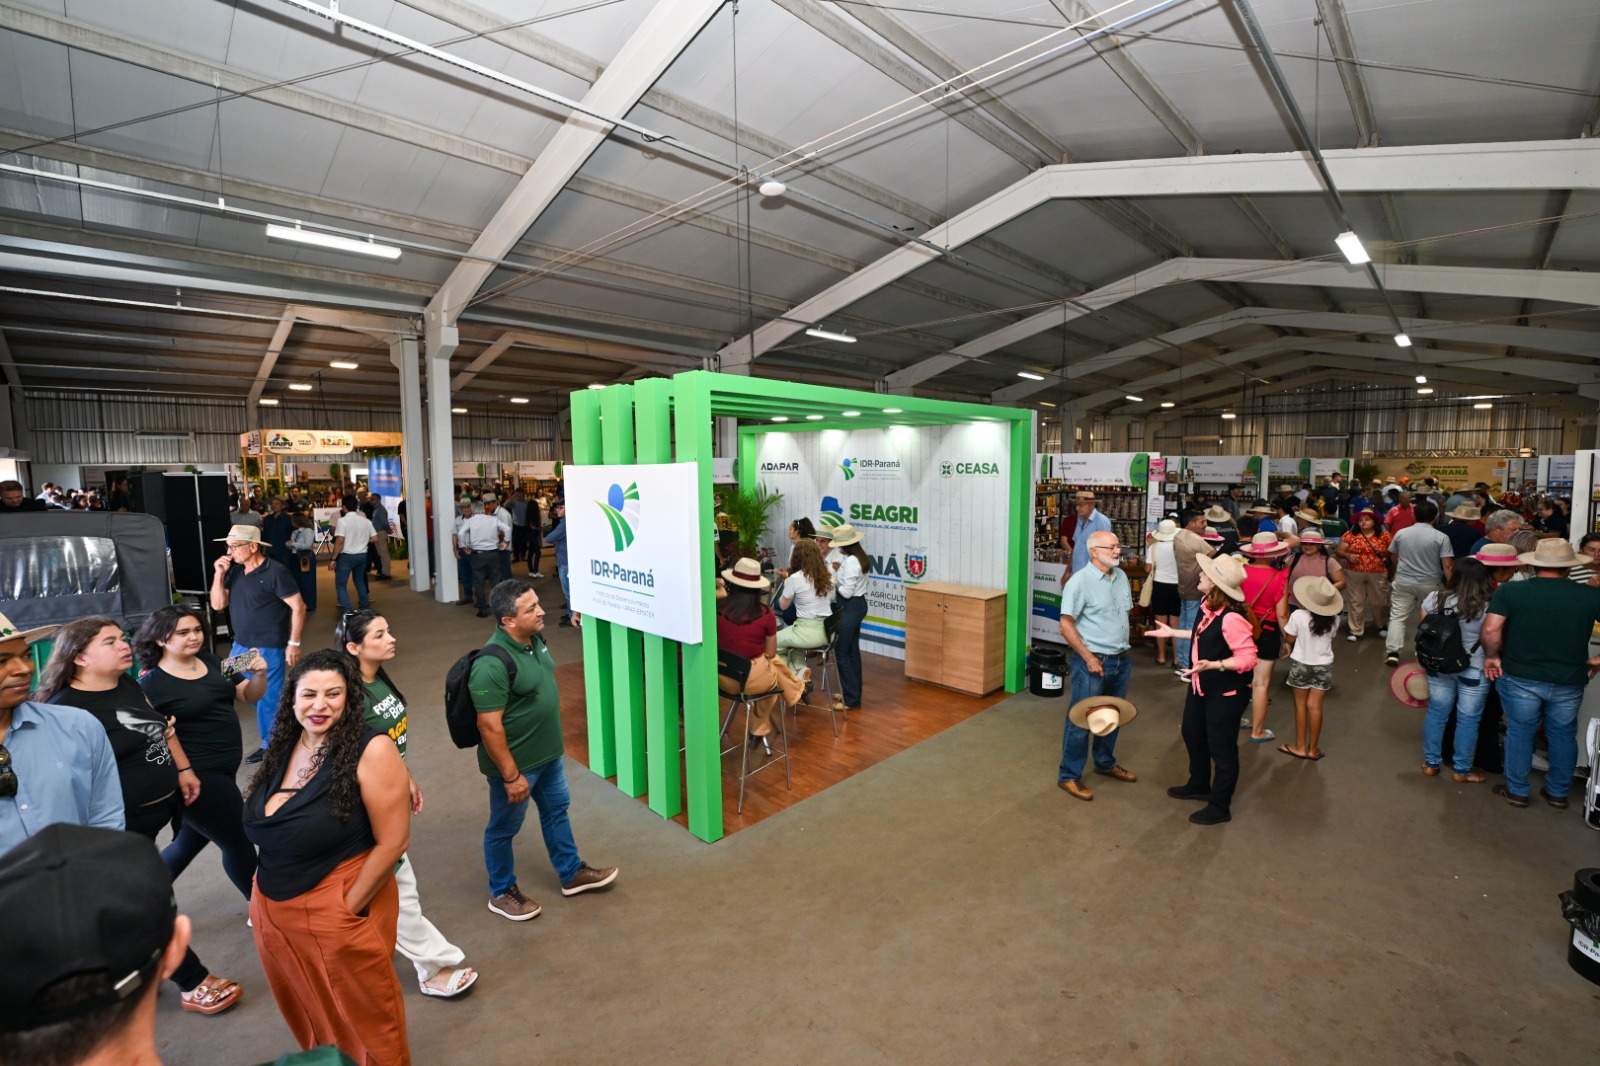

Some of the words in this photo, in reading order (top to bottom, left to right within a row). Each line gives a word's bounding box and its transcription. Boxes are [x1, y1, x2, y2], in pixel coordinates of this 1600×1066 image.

[761, 463, 799, 471] ADAPAR
[956, 463, 1000, 474] CEASA
[1430, 468, 1469, 476] PARANÁ
[849, 503, 918, 525] SEAGRI
[867, 553, 902, 578] NÁ
[886, 582, 905, 590] EST
[870, 590, 906, 602] AGRICULT
[866, 598, 906, 612] ECIMENTO
[373, 694, 396, 715] FORÇA
[388, 717, 407, 740] AGR
[1577, 939, 1600, 957] IDR-Pa
